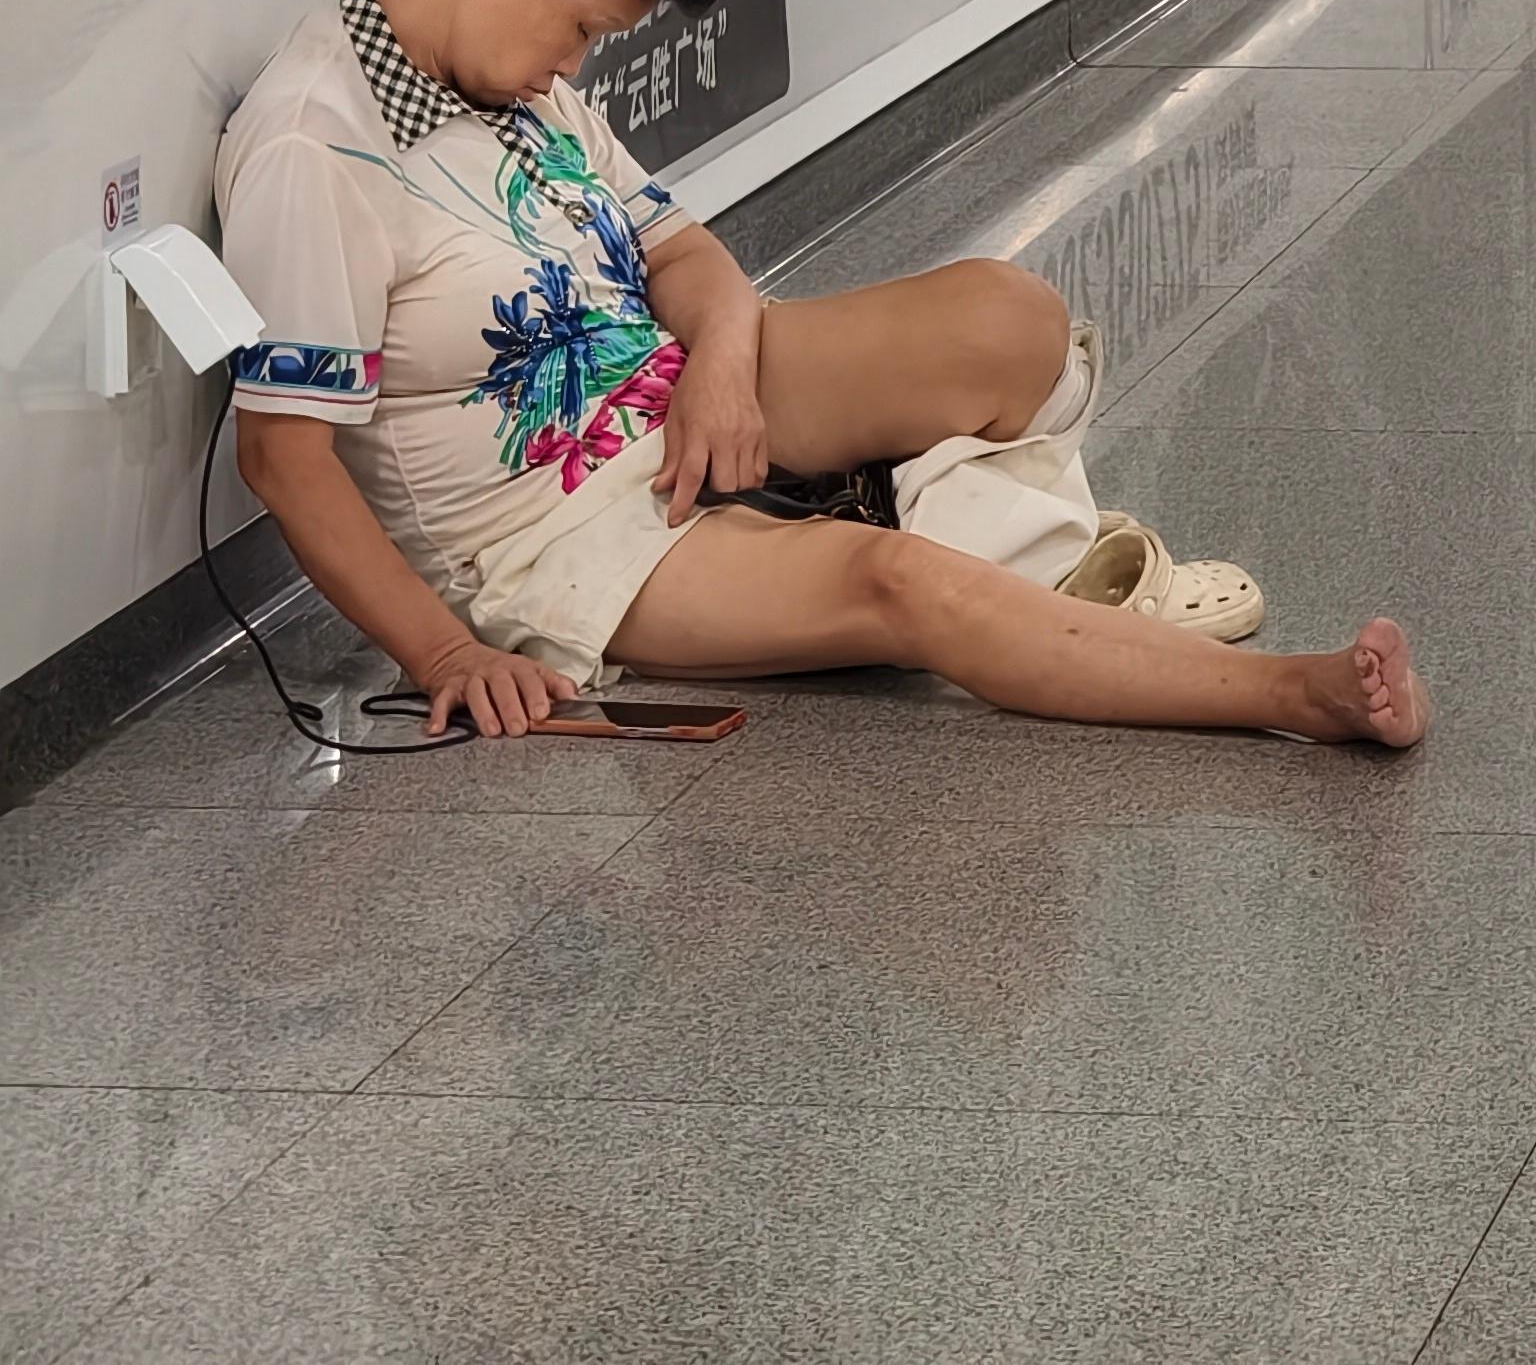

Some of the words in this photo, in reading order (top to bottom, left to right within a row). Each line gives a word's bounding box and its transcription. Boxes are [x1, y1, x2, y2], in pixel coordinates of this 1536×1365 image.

[576, 7, 727, 133] 航“云胜广场”
